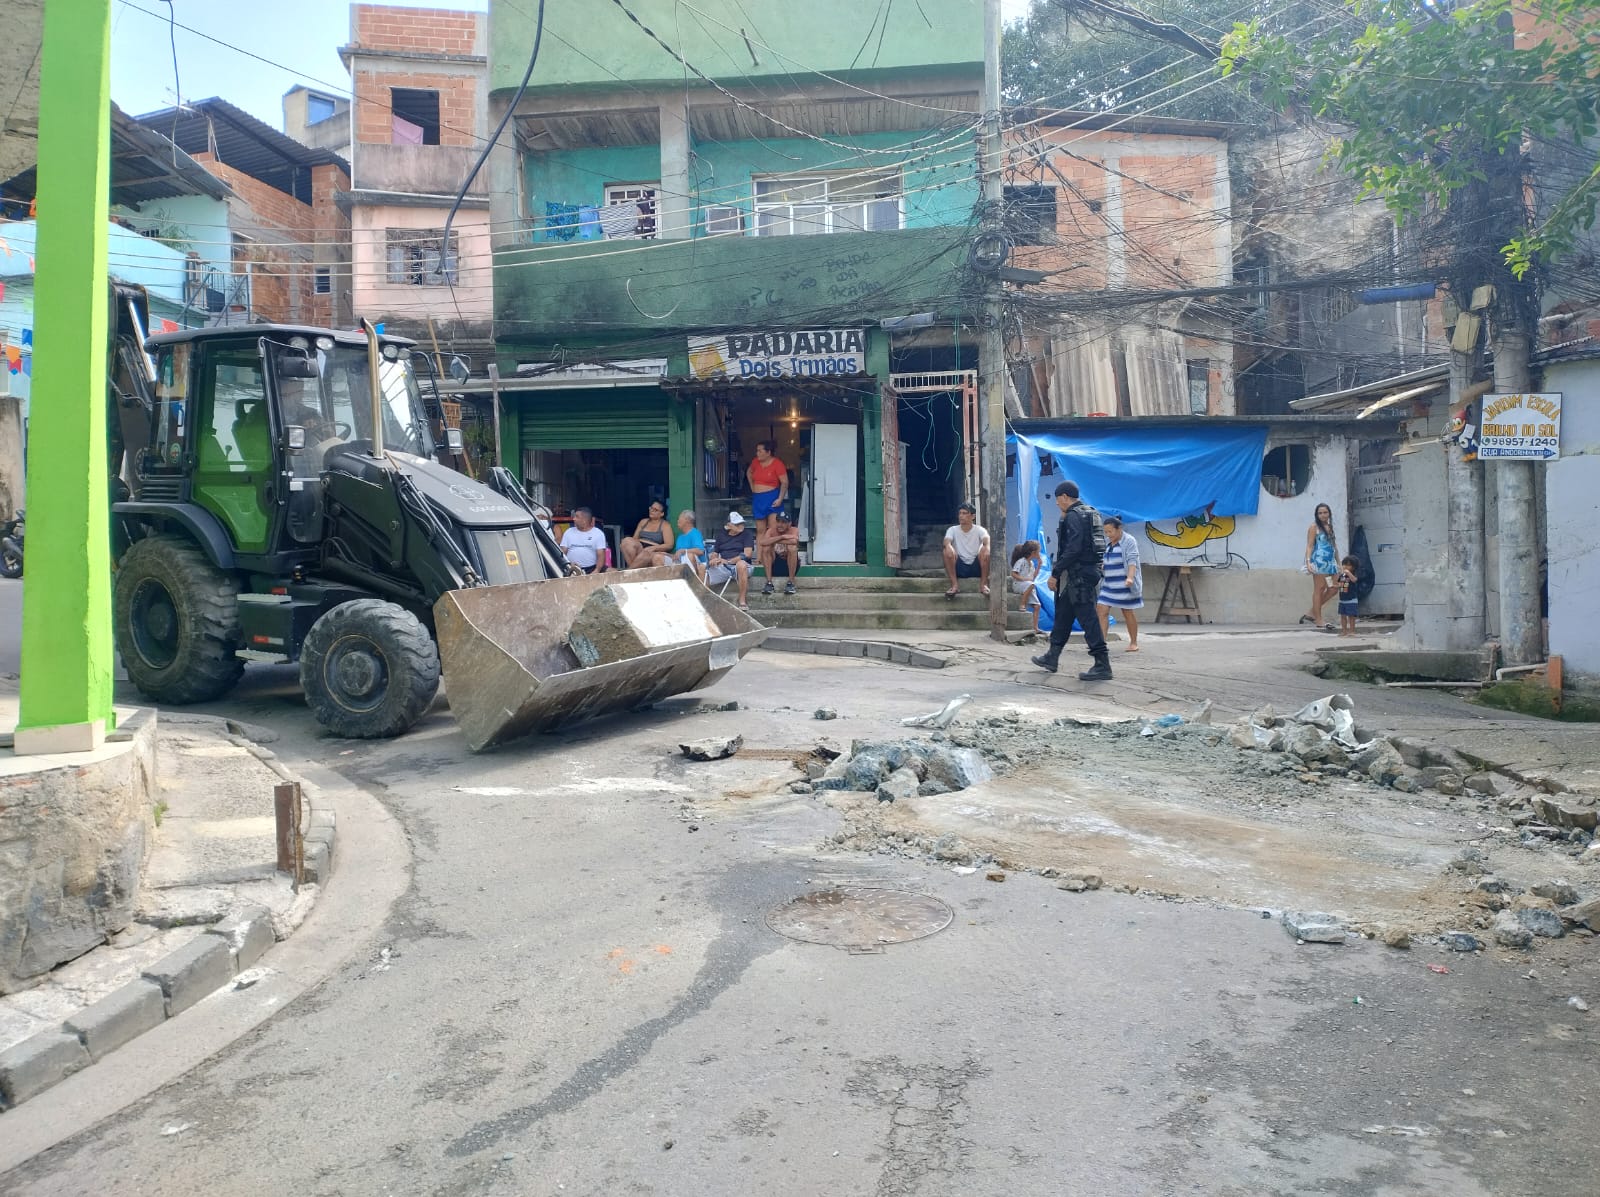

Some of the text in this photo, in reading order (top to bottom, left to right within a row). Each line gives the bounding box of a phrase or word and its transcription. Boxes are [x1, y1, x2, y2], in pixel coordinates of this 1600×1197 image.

[725, 330, 864, 358] PADARIA
[739, 355, 858, 377] Dois Irmãos
[1482, 394, 1561, 421] JARDIM ESCOLA
[1482, 423, 1558, 437] BRILHO DO SOL
[1482, 448, 1498, 457] RUA
